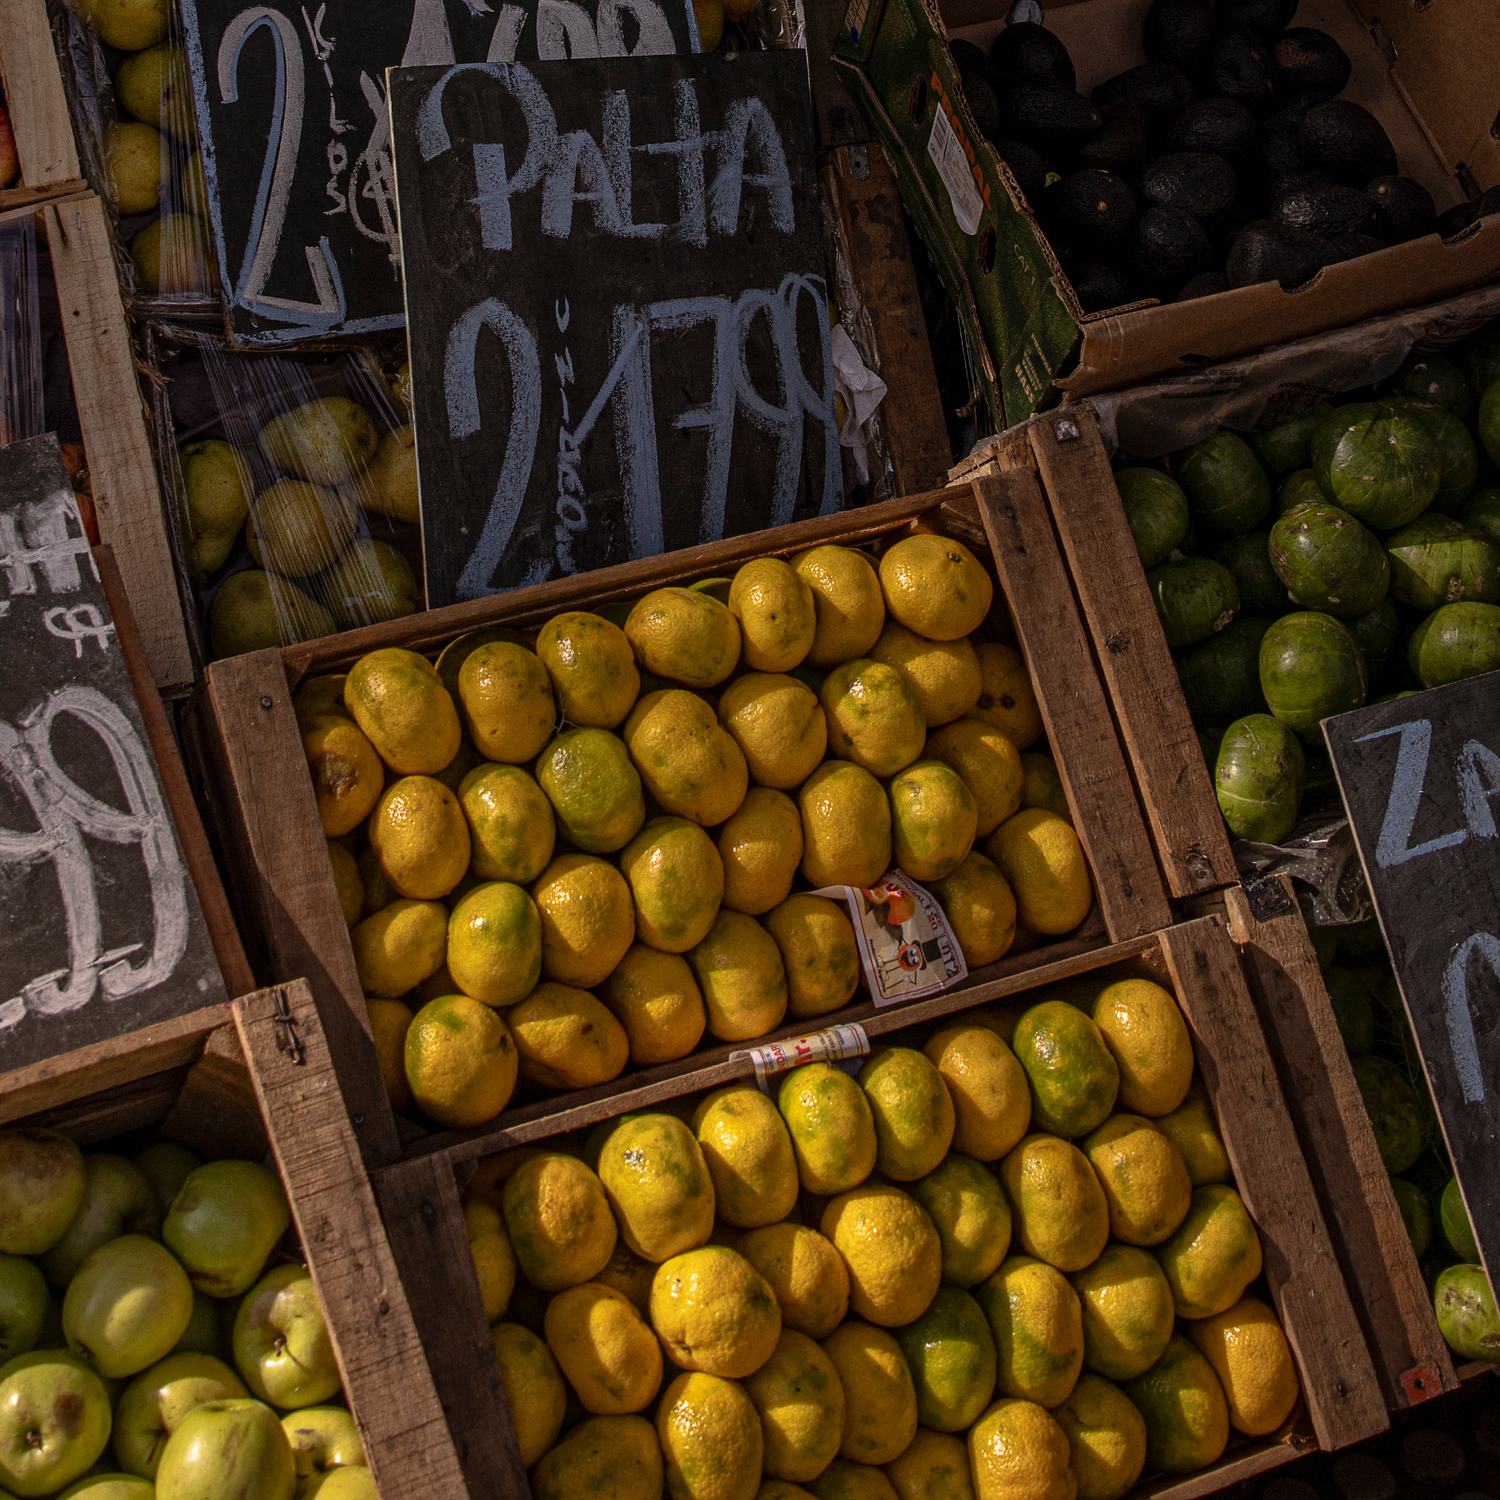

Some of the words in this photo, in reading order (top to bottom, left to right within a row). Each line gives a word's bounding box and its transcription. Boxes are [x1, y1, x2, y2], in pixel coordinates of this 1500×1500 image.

[414, 61, 796, 252] PALTA
[930, 69, 992, 211] PROPAL
[1013, 243, 1031, 273] CAT
[443, 296, 554, 600] 2
[572, 271, 846, 562] 1799
[1014, 363, 1035, 404] HASS
